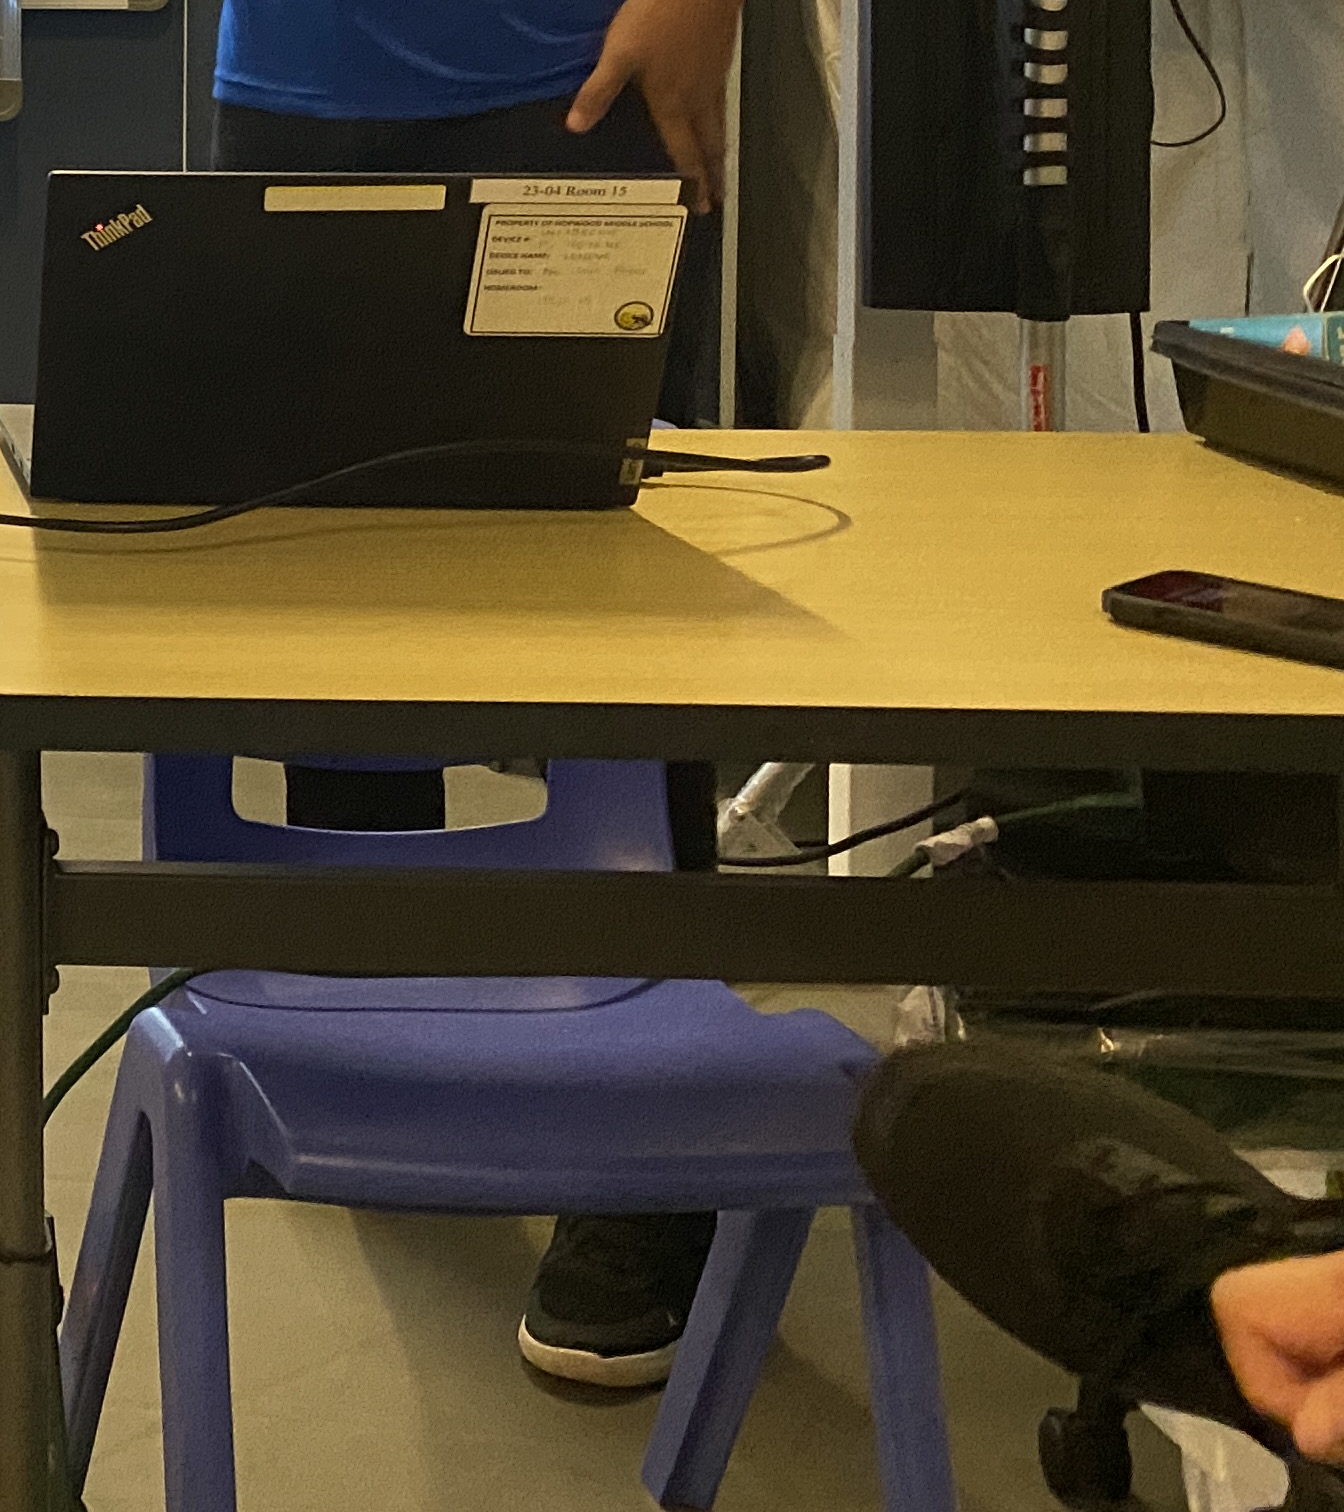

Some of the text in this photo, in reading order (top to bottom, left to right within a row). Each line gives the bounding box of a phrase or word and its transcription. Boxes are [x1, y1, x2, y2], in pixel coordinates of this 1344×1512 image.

[565, 186, 606, 197] Room
[612, 185, 628, 197] 15
[80, 203, 153, 251] ThinkPad
